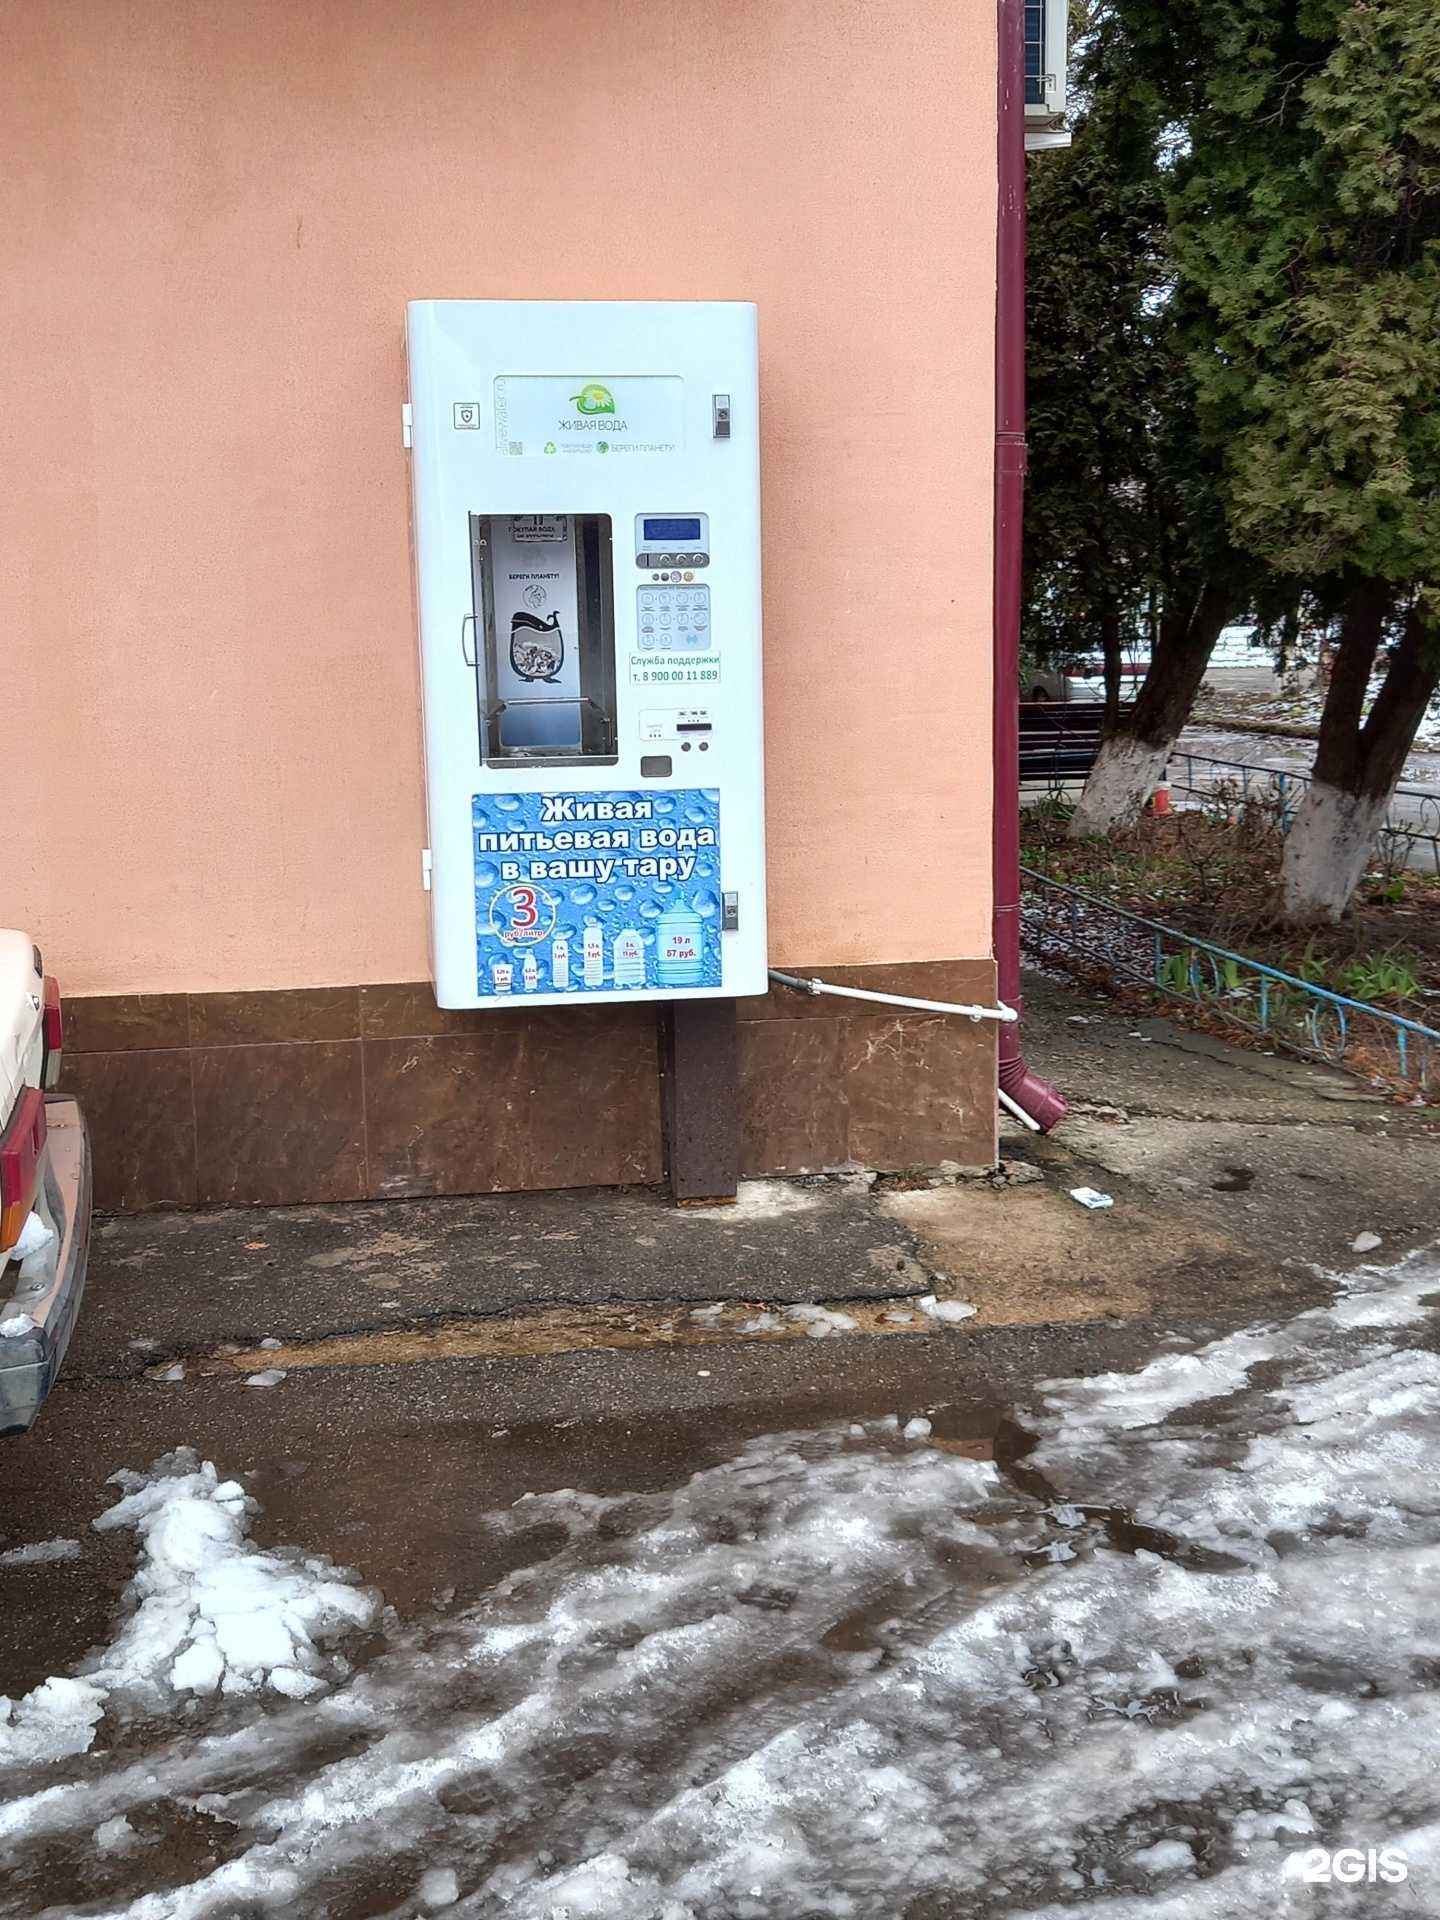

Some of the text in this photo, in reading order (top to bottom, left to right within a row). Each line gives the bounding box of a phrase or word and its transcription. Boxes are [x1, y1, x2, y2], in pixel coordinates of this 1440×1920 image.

[558, 420, 628, 431] ЖИВАЯ ВОДА
[631, 655, 720, 667] Служба поддержки
[642, 671, 649, 681] 8
[651, 671, 669, 681] 900
[671, 671, 684, 681] 00
[686, 670, 698, 680] 11
[700, 670, 718, 680] 889
[540, 796, 653, 822] Живая
[478, 826, 717, 853] питьевая вода
[501, 855, 698, 884] в вашу тару
[511, 887, 538, 928] 3
[672, 936, 683, 945] 19
[666, 948, 697, 959] 57 руб.
